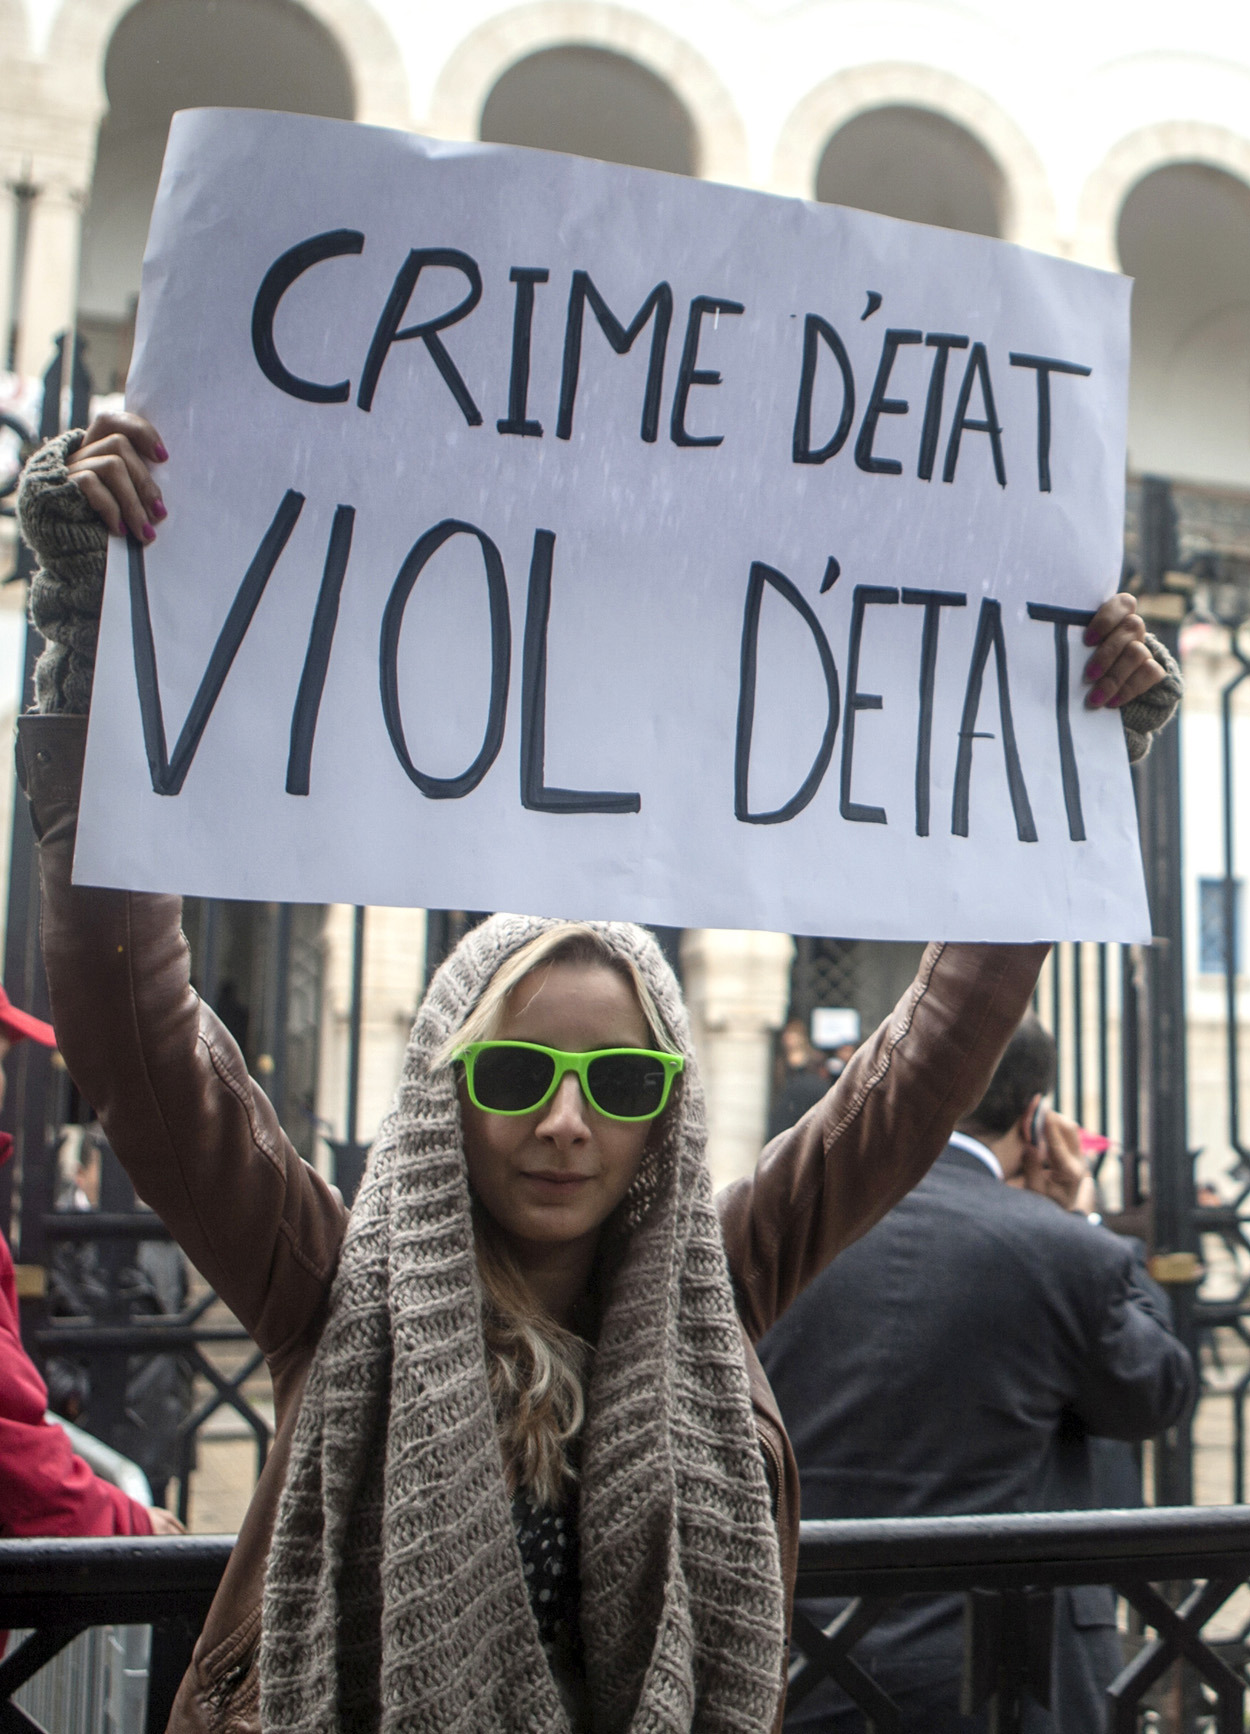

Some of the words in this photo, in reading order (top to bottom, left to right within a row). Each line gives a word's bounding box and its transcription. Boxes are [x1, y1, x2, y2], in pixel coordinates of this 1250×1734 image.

[250, 227, 746, 448] CRIME
[791, 290, 1094, 494] D'ETAT
[126, 489, 642, 815] VIOL
[733, 555, 1100, 844] D'ETAT
